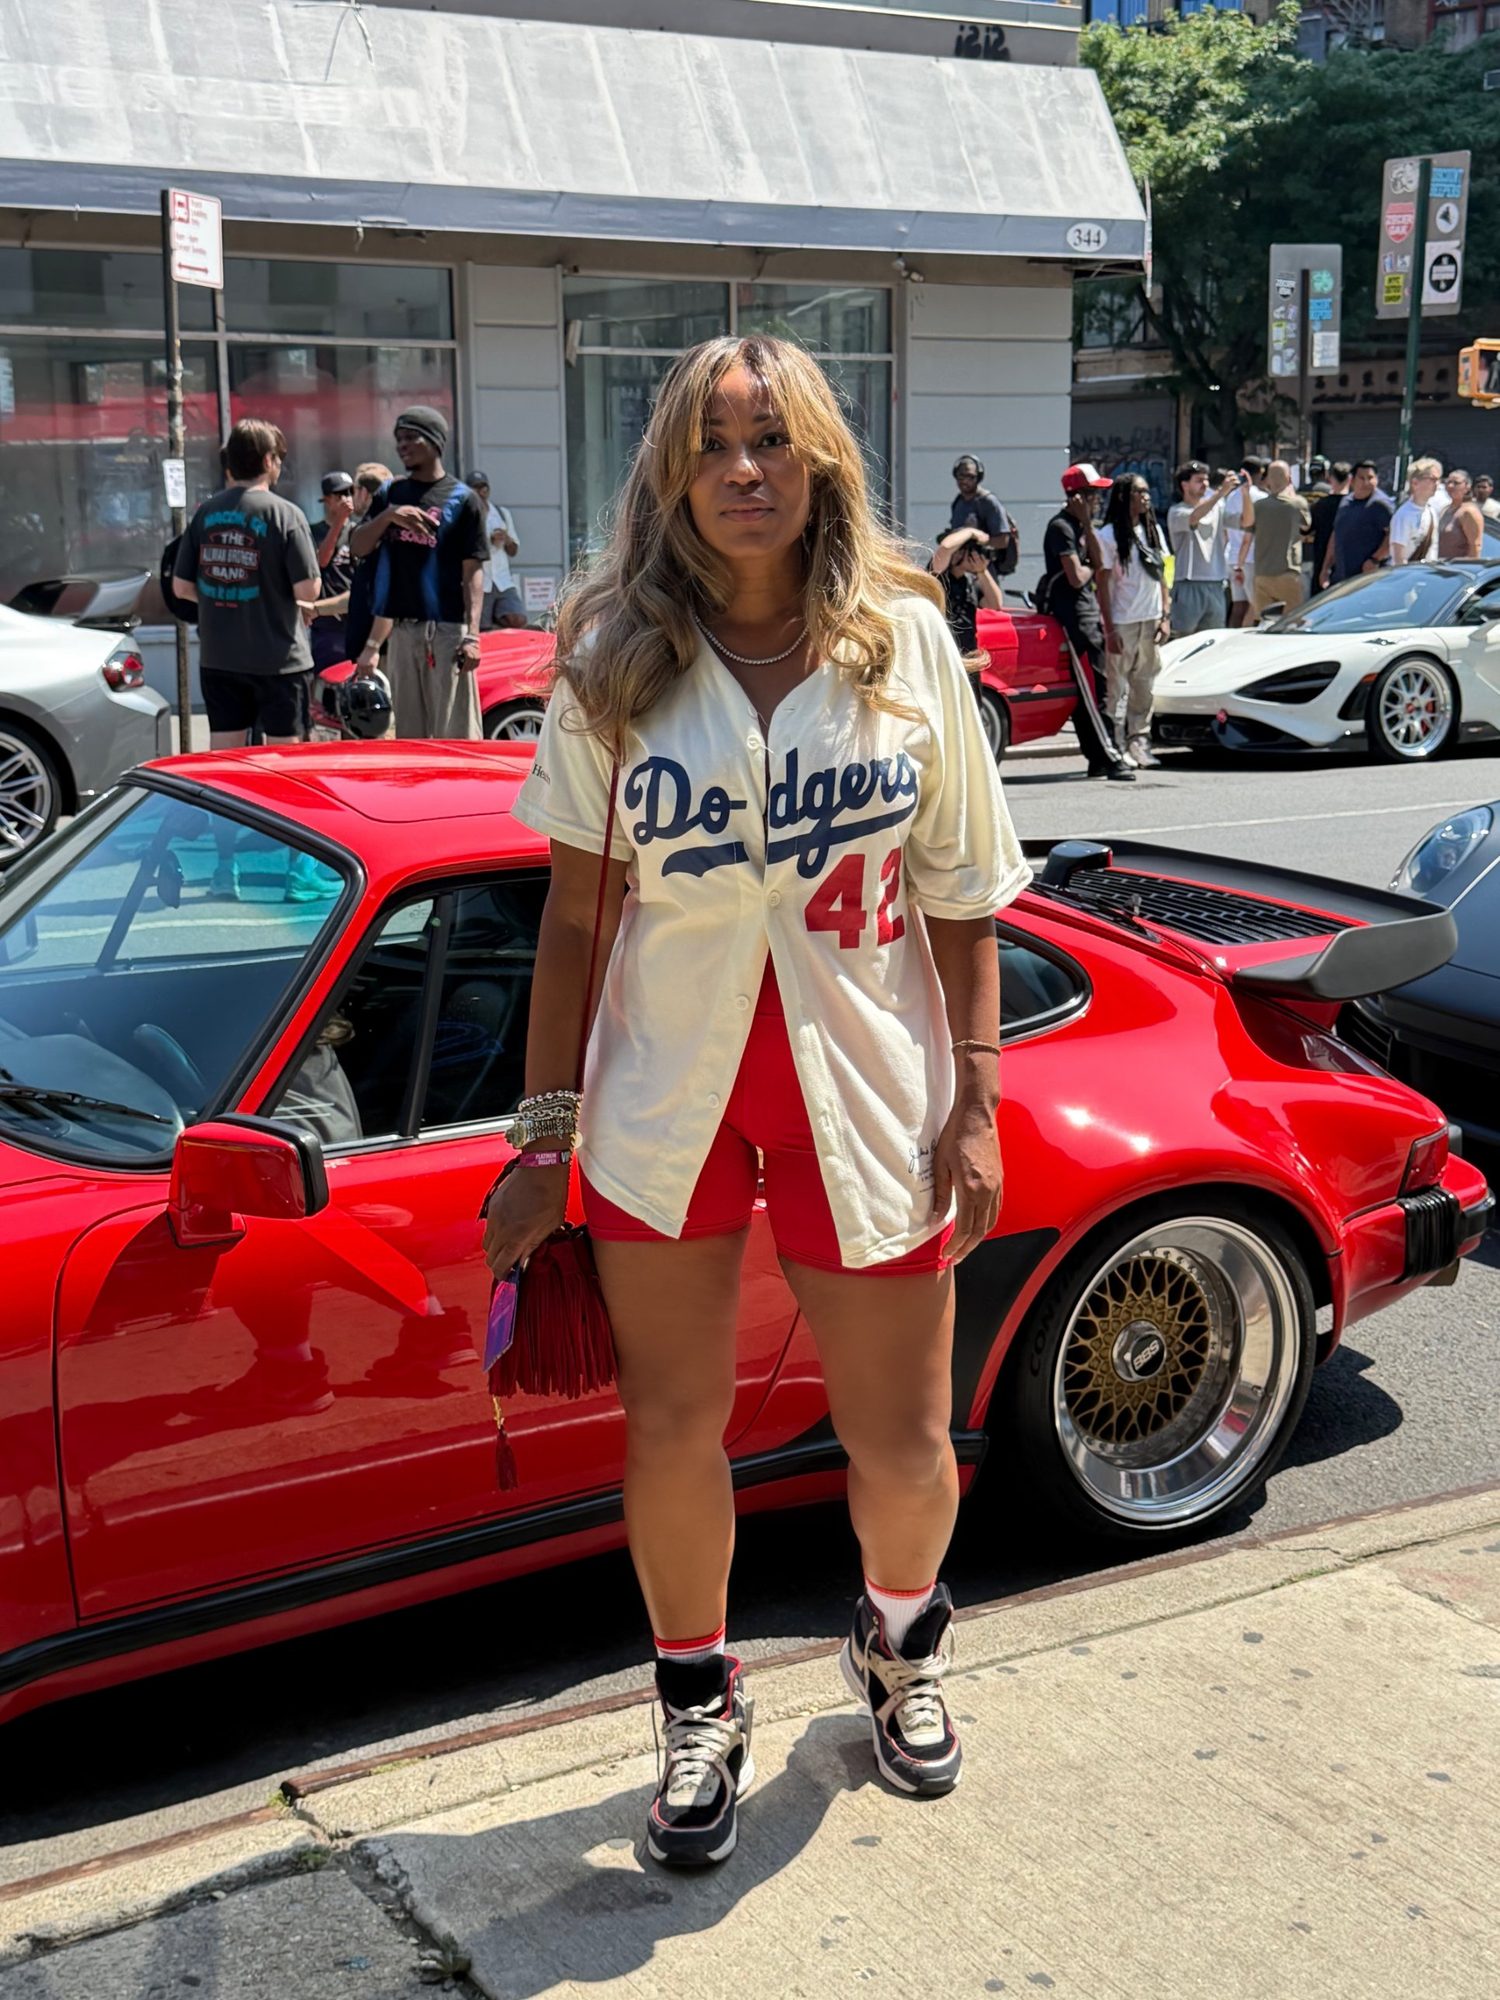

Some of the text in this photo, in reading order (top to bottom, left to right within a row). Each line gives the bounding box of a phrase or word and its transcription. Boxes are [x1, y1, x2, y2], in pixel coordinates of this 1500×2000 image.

[1073, 229, 1101, 247] 344
[221, 532, 246, 546] THE
[212, 566, 246, 579] BAND
[625, 751, 918, 879] Dodgers
[804, 846, 905, 949] 42
[1133, 1340, 1160, 1371] BBS
